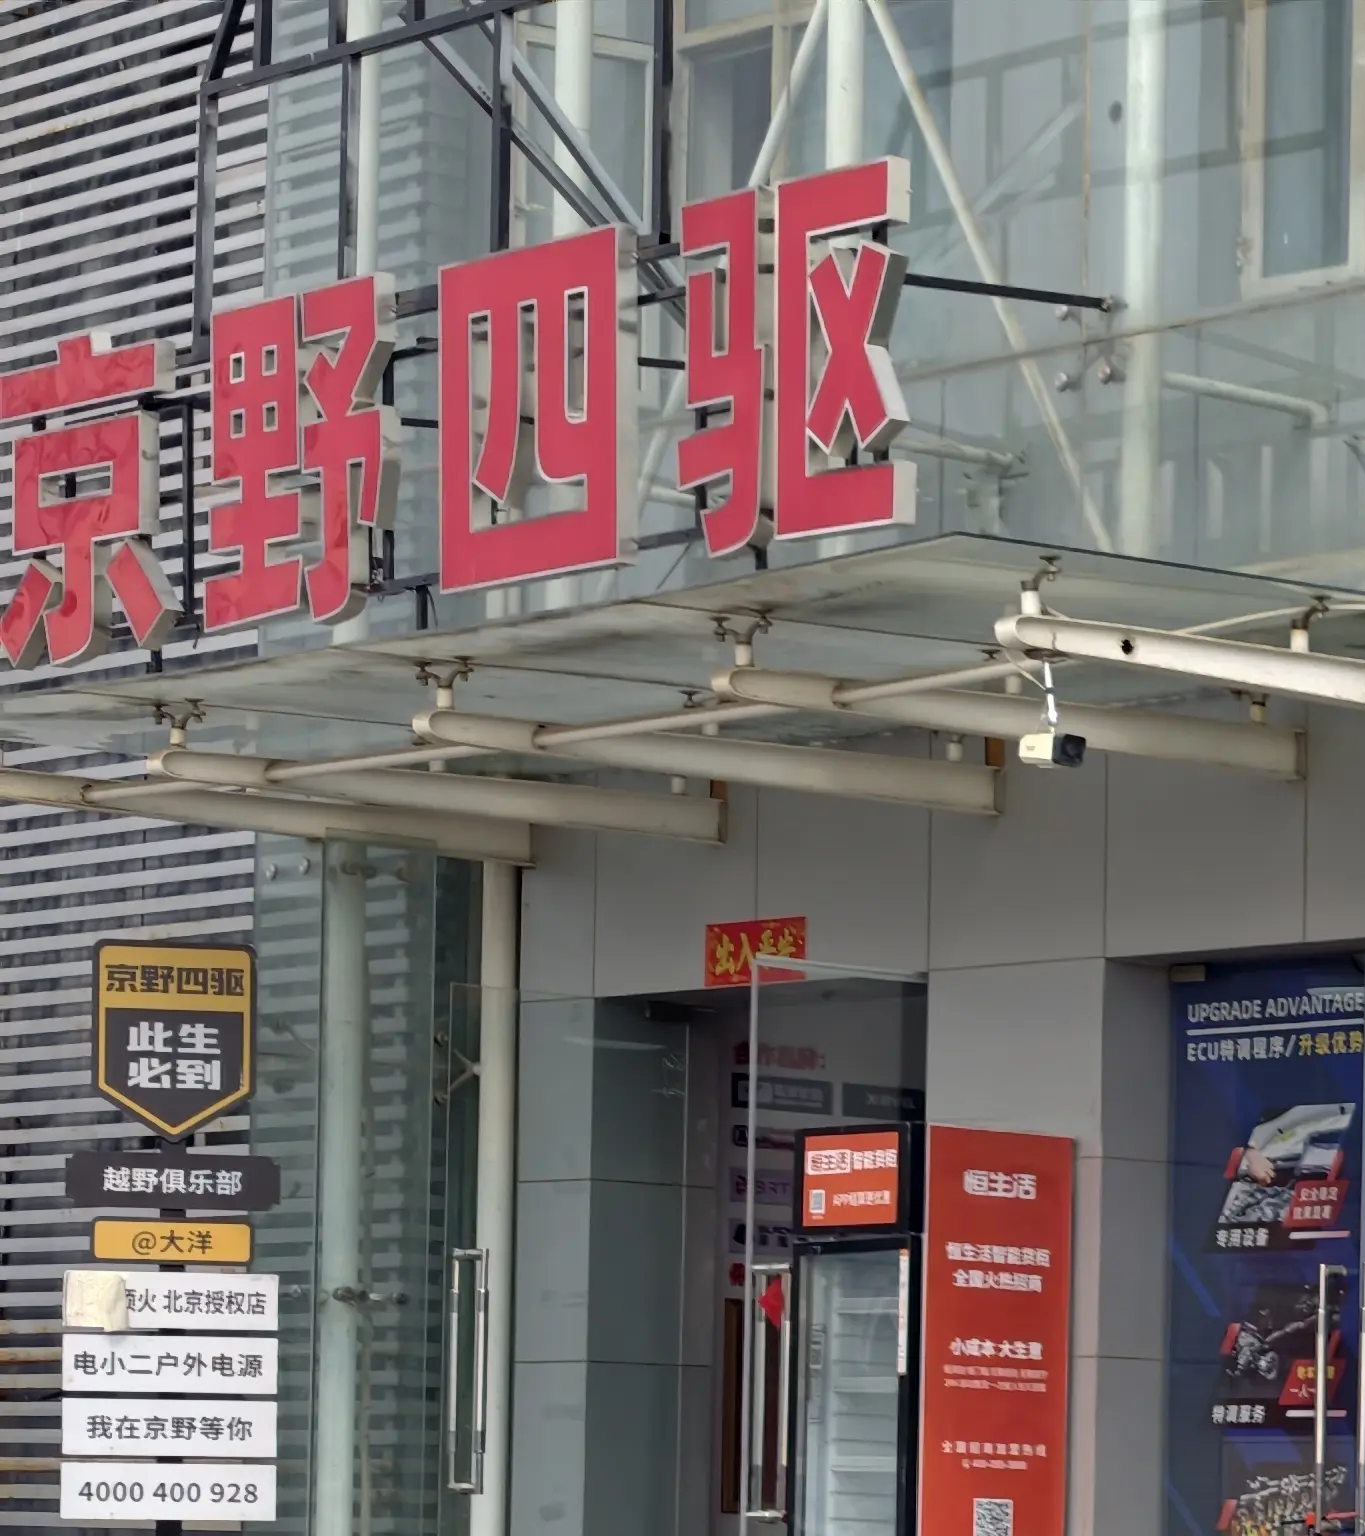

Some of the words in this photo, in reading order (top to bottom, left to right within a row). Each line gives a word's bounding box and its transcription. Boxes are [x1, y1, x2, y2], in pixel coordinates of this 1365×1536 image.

[0, 156, 915, 671] 京野四驱
[105, 963, 245, 997] 京野四驱
[1186, 998, 1262, 1024] UPGRADE
[1265, 991, 1365, 1019] ADVANTAGE
[126, 1021, 221, 1054] 此生
[126, 1057, 221, 1091] 必到
[102, 1166, 243, 1196] 越野俱乐部
[963, 1169, 1037, 1200] 恒生活
[132, 1229, 214, 1256] @大洋
[163, 1289, 267, 1316] 北京授权店
[73, 1351, 263, 1378] 电小二户外电源
[86, 1414, 253, 1442] 我在京野等你
[78, 1481, 145, 1503] 4000
[152, 1481, 202, 1503] 400
[209, 1482, 259, 1504] 928
